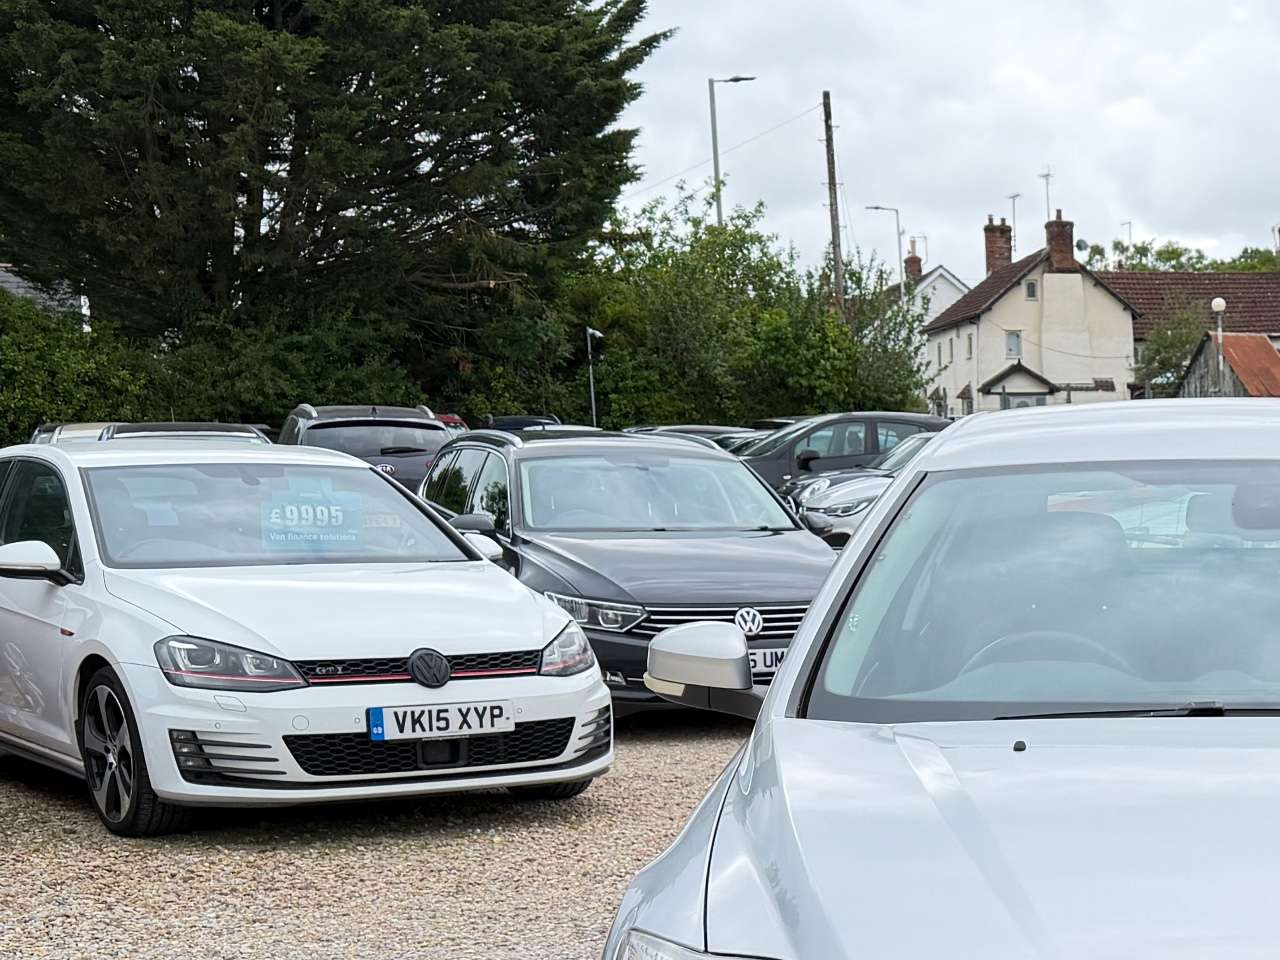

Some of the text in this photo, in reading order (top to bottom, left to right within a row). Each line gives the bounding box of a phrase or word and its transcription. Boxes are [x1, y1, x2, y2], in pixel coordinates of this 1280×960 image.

[269, 505, 344, 527] £9995
[315, 666, 343, 675] GTI
[393, 705, 504, 734] VK15 XYP
